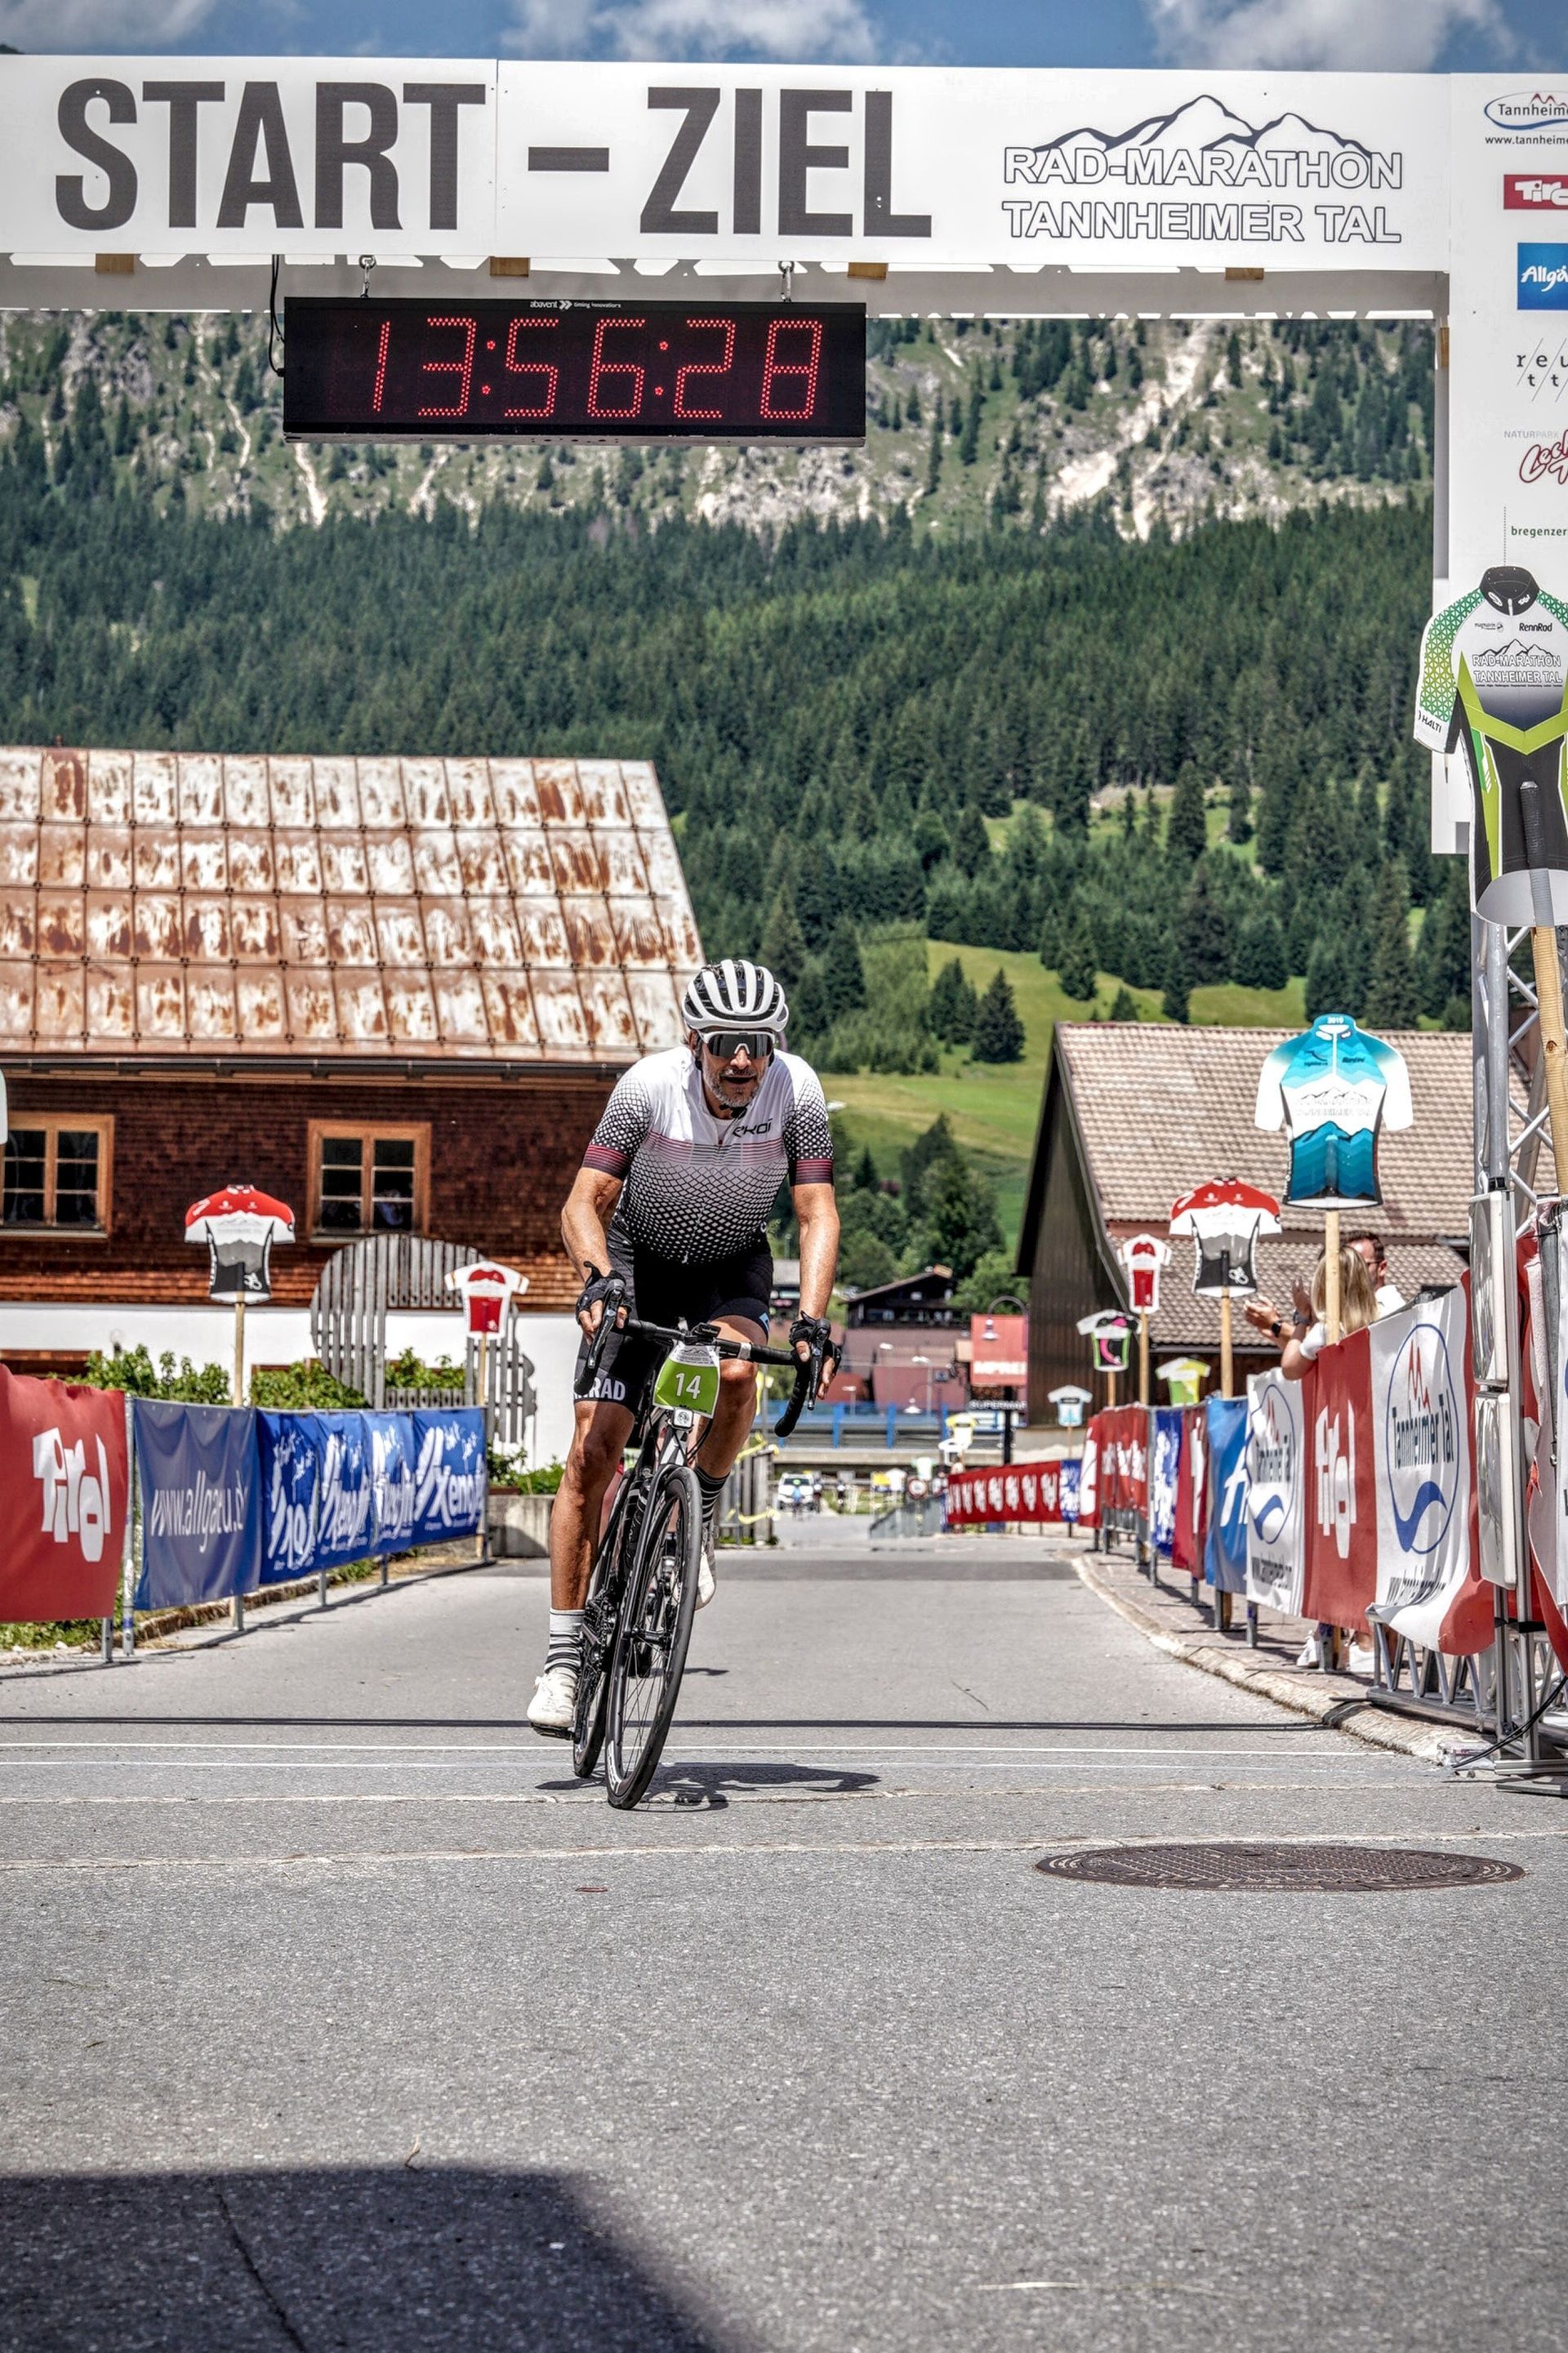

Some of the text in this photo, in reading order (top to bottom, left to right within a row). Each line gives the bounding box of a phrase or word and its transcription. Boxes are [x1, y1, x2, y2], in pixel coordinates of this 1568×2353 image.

[1498, 103, 1568, 116] Tannheim
[1485, 135, 1568, 145] www.tannheim
[56, 78, 486, 230] START
[640, 87, 932, 238] ZIEL
[1004, 147, 1402, 189] RAD-MARATHON
[1002, 201, 1401, 243] TANNHEIMER TAL
[373, 318, 822, 418] 13:56:28
[1503, 430, 1559, 439] NATURPARK
[1472, 654, 1561, 666] RAD-MARATHON
[1473, 671, 1562, 683] TANNHEIMER TAL
[573, 1377, 626, 1401] RAD
[675, 1373, 702, 1400] 14
[1392, 1389, 1454, 1469] Tannheimer Tal
[33, 1427, 111, 1562] Tirol
